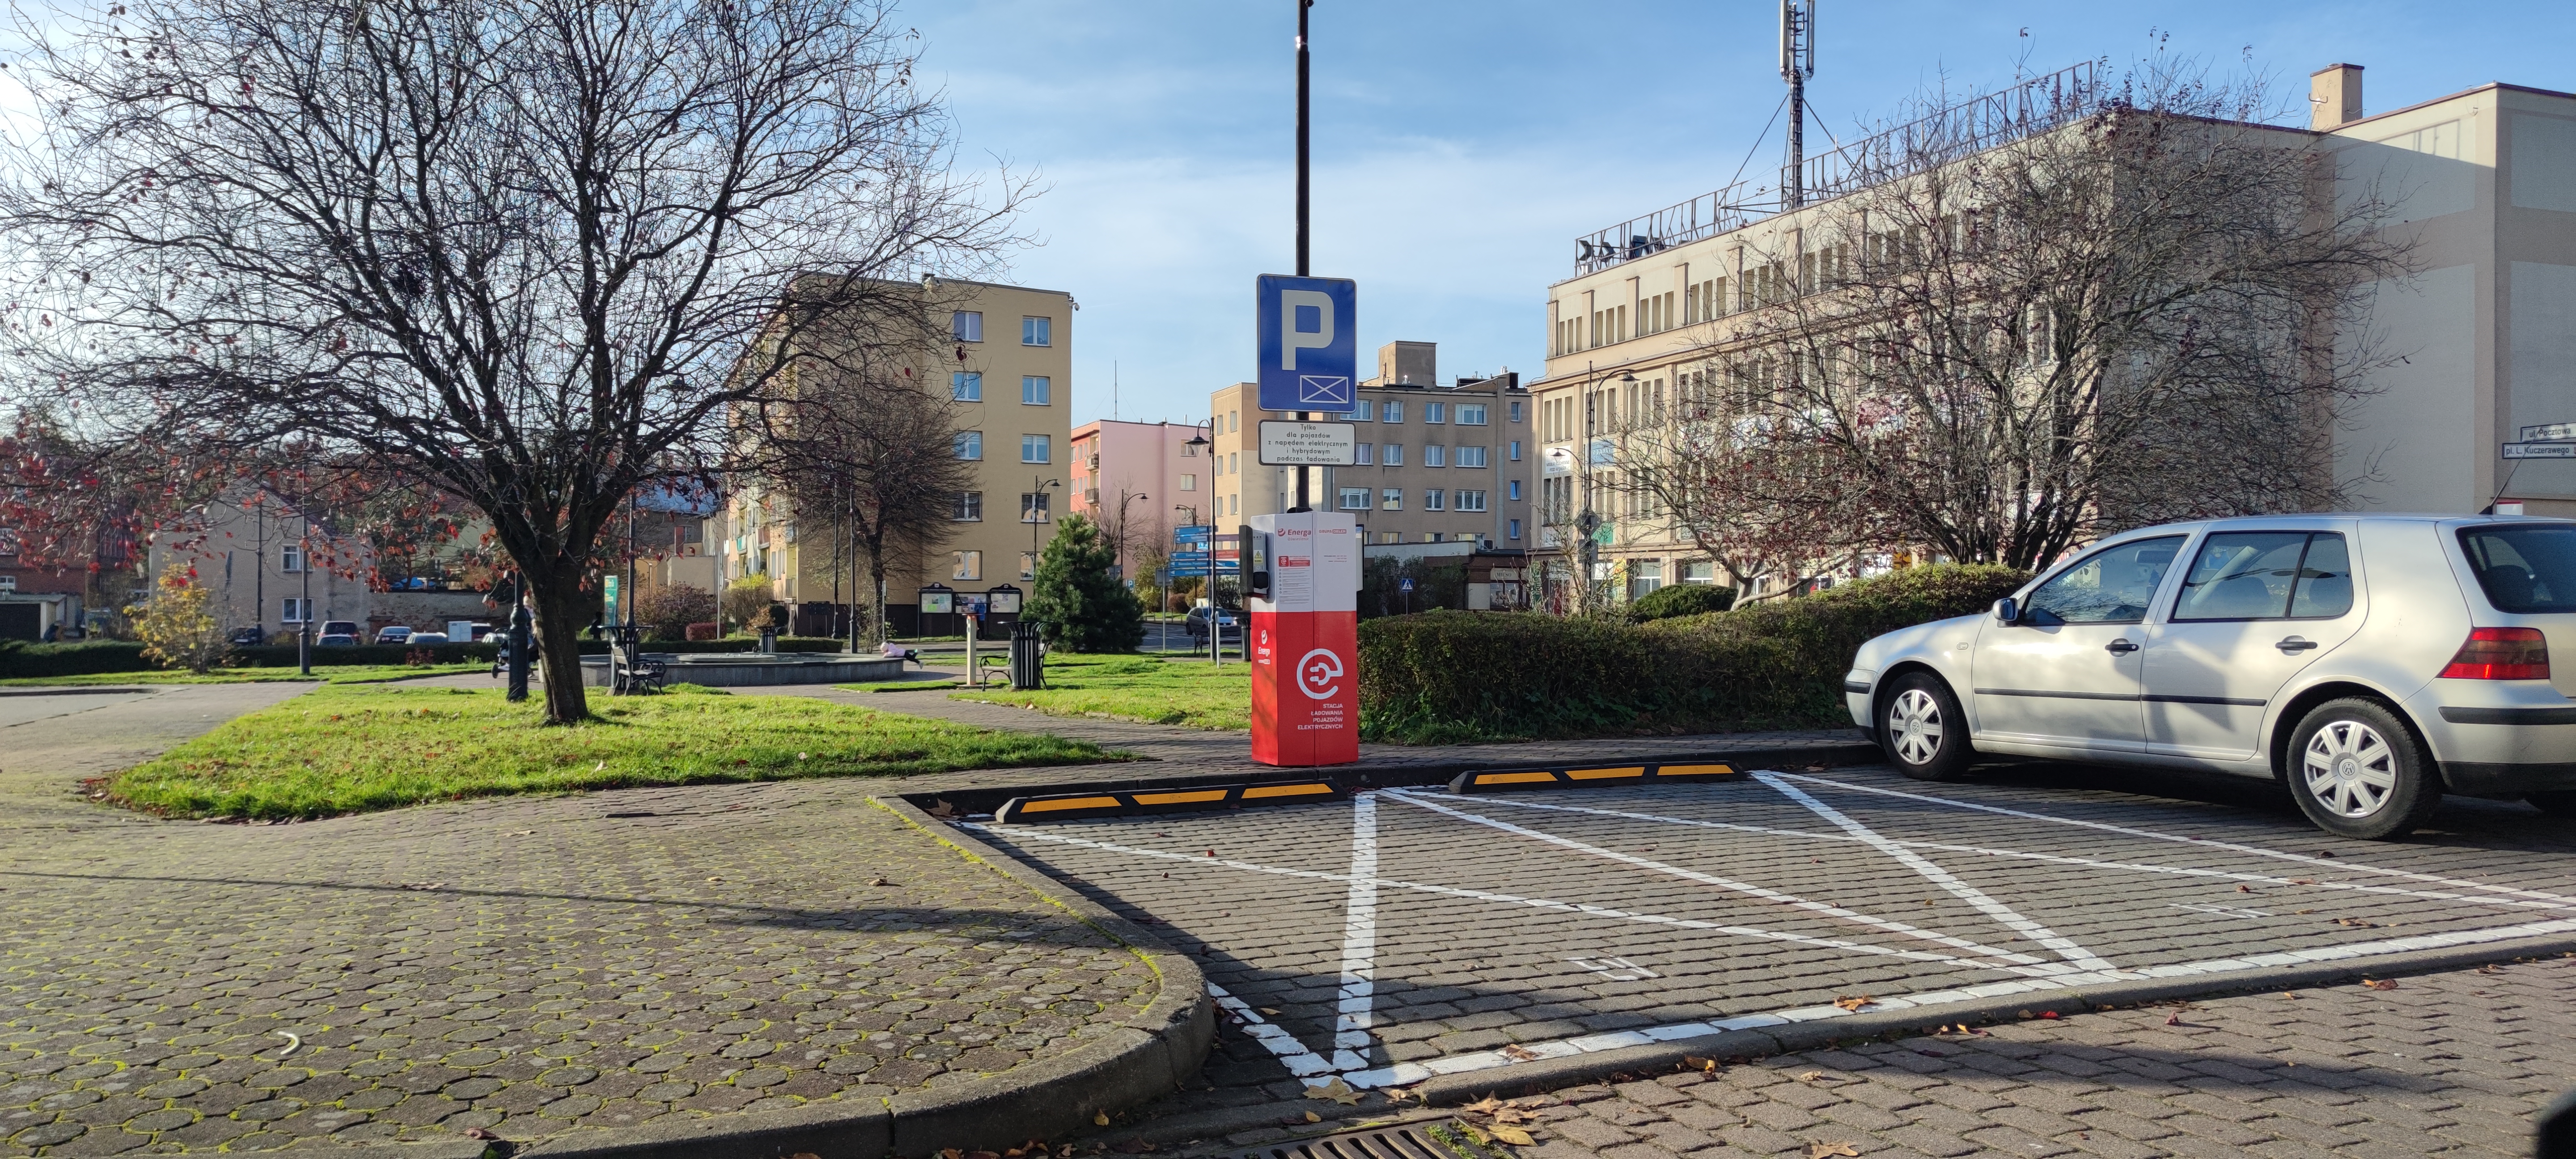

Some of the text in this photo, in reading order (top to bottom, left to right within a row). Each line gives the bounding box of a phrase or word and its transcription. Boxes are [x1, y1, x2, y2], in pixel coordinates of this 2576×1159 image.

[1282, 289, 1334, 371] P
[2538, 428, 2571, 437] Pocztowa
[1308, 440, 1348, 448] elektrycznym
[2506, 447, 2514, 456] pl.
[2524, 447, 2569, 456] Kuczerawego
